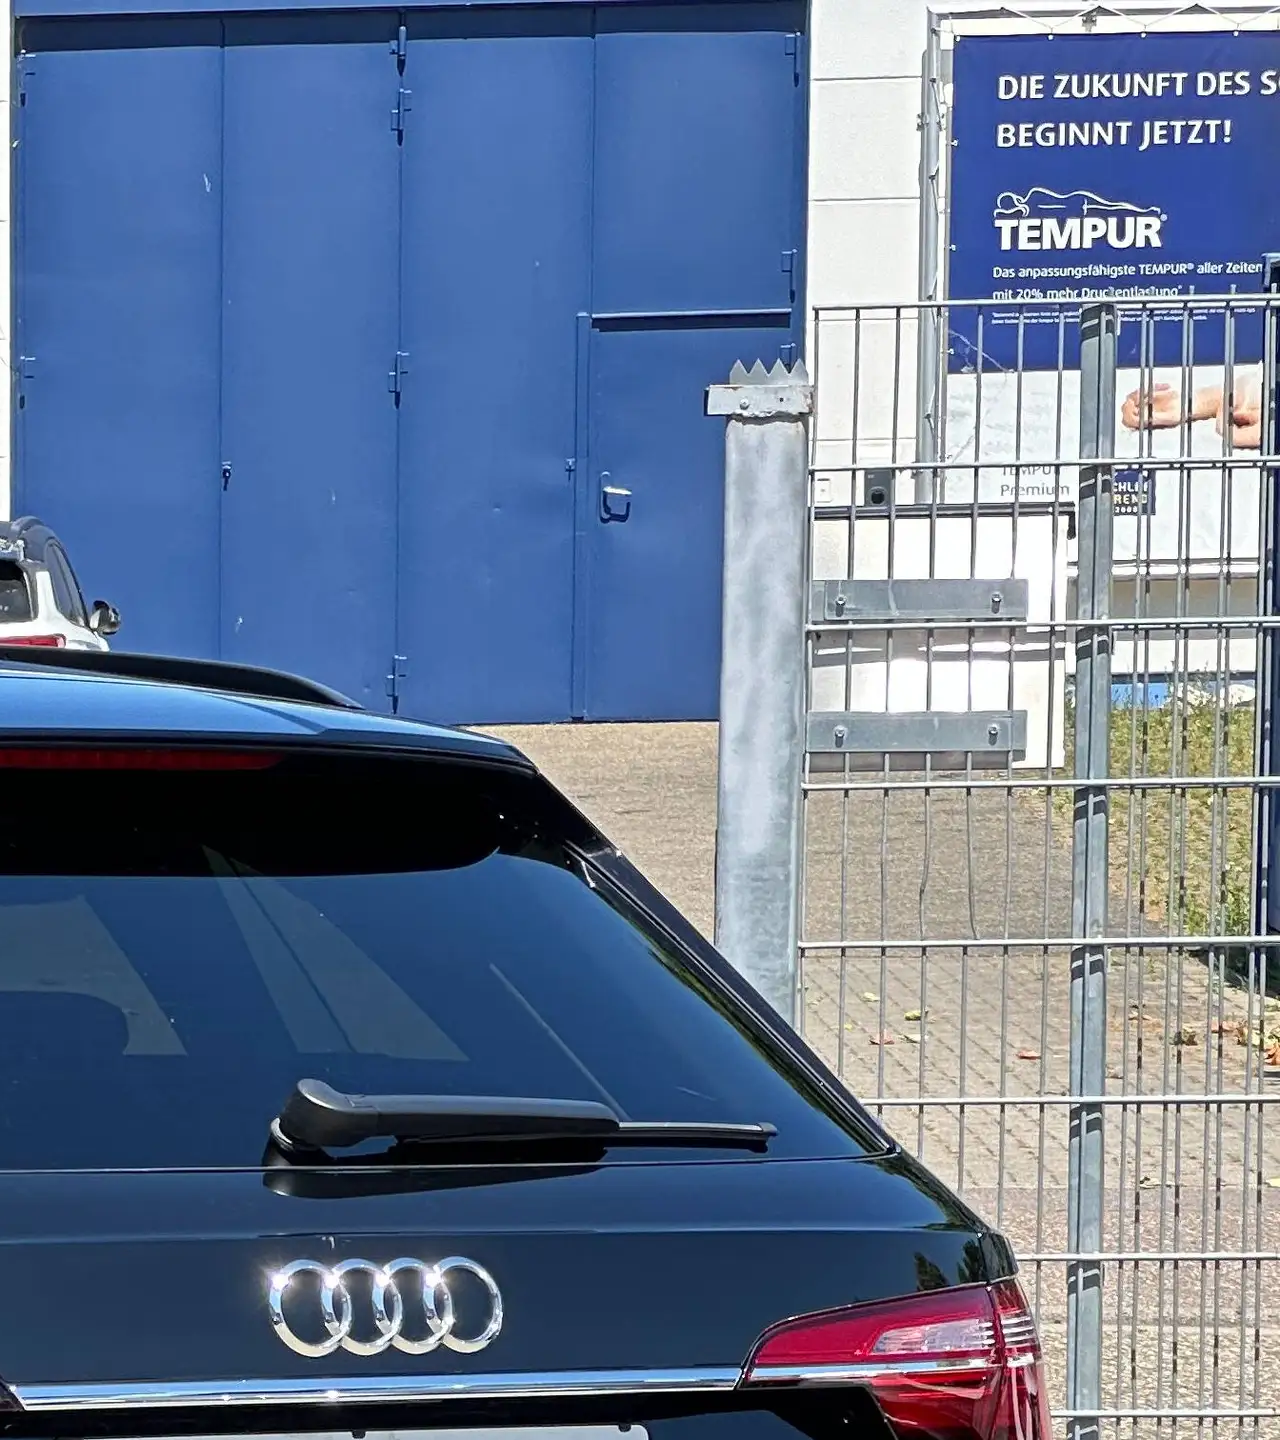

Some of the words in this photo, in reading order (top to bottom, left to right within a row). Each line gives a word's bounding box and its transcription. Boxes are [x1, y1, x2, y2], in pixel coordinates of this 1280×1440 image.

[997, 75, 1044, 100] DIE
[1053, 72, 1188, 99] ZUKUNFT
[1197, 71, 1251, 96] DES
[1260, 70, 1280, 95] S
[996, 121, 1133, 148] BEGINNT
[1139, 120, 1233, 151] JETZT!
[992, 266, 1016, 279] Das
[1018, 264, 1135, 279] anpassungsfähigste
[1197, 262, 1224, 274] aller
[992, 289, 1013, 300] mit
[1016, 289, 1044, 300] 20%
